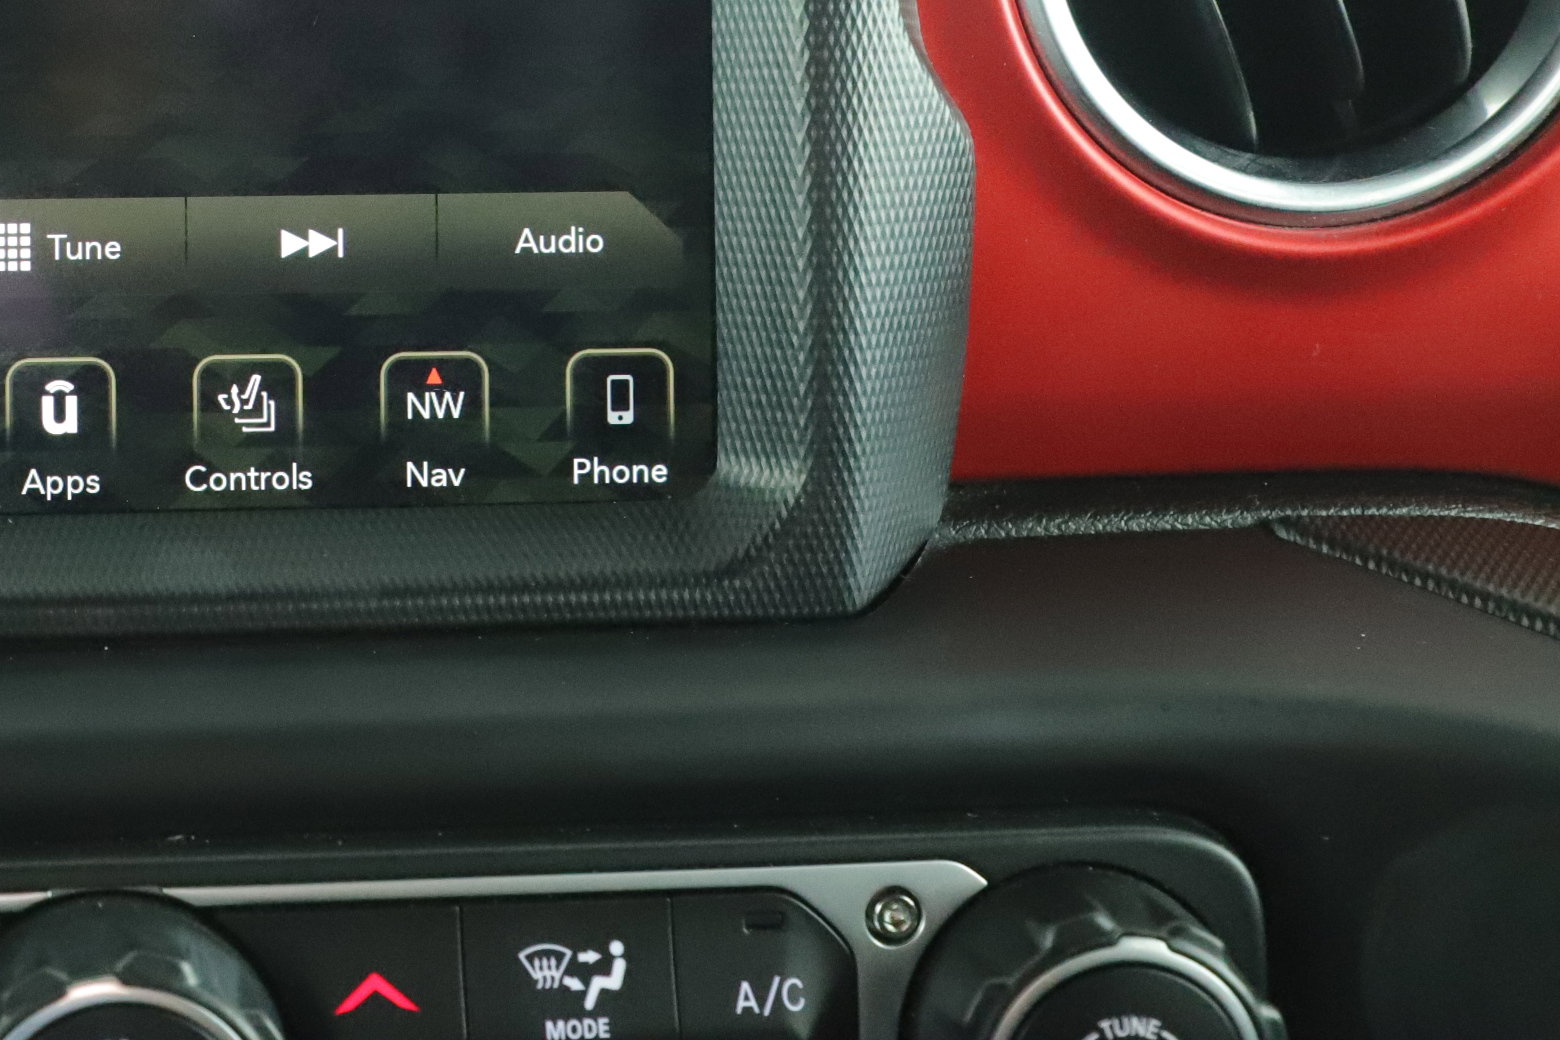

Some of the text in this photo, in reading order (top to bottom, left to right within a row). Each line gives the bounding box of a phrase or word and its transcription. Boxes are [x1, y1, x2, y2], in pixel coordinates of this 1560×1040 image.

[46, 234, 122, 261] Tune
[514, 225, 605, 255] Audio
[405, 391, 466, 421] NW
[21, 468, 101, 501] Apps
[183, 462, 314, 493] Controls
[405, 461, 467, 489] Nav
[572, 456, 669, 486] Phone
[735, 975, 806, 1017] A/C
[544, 1016, 611, 1040] MODE
[1097, 1014, 1162, 1040] TUNE
